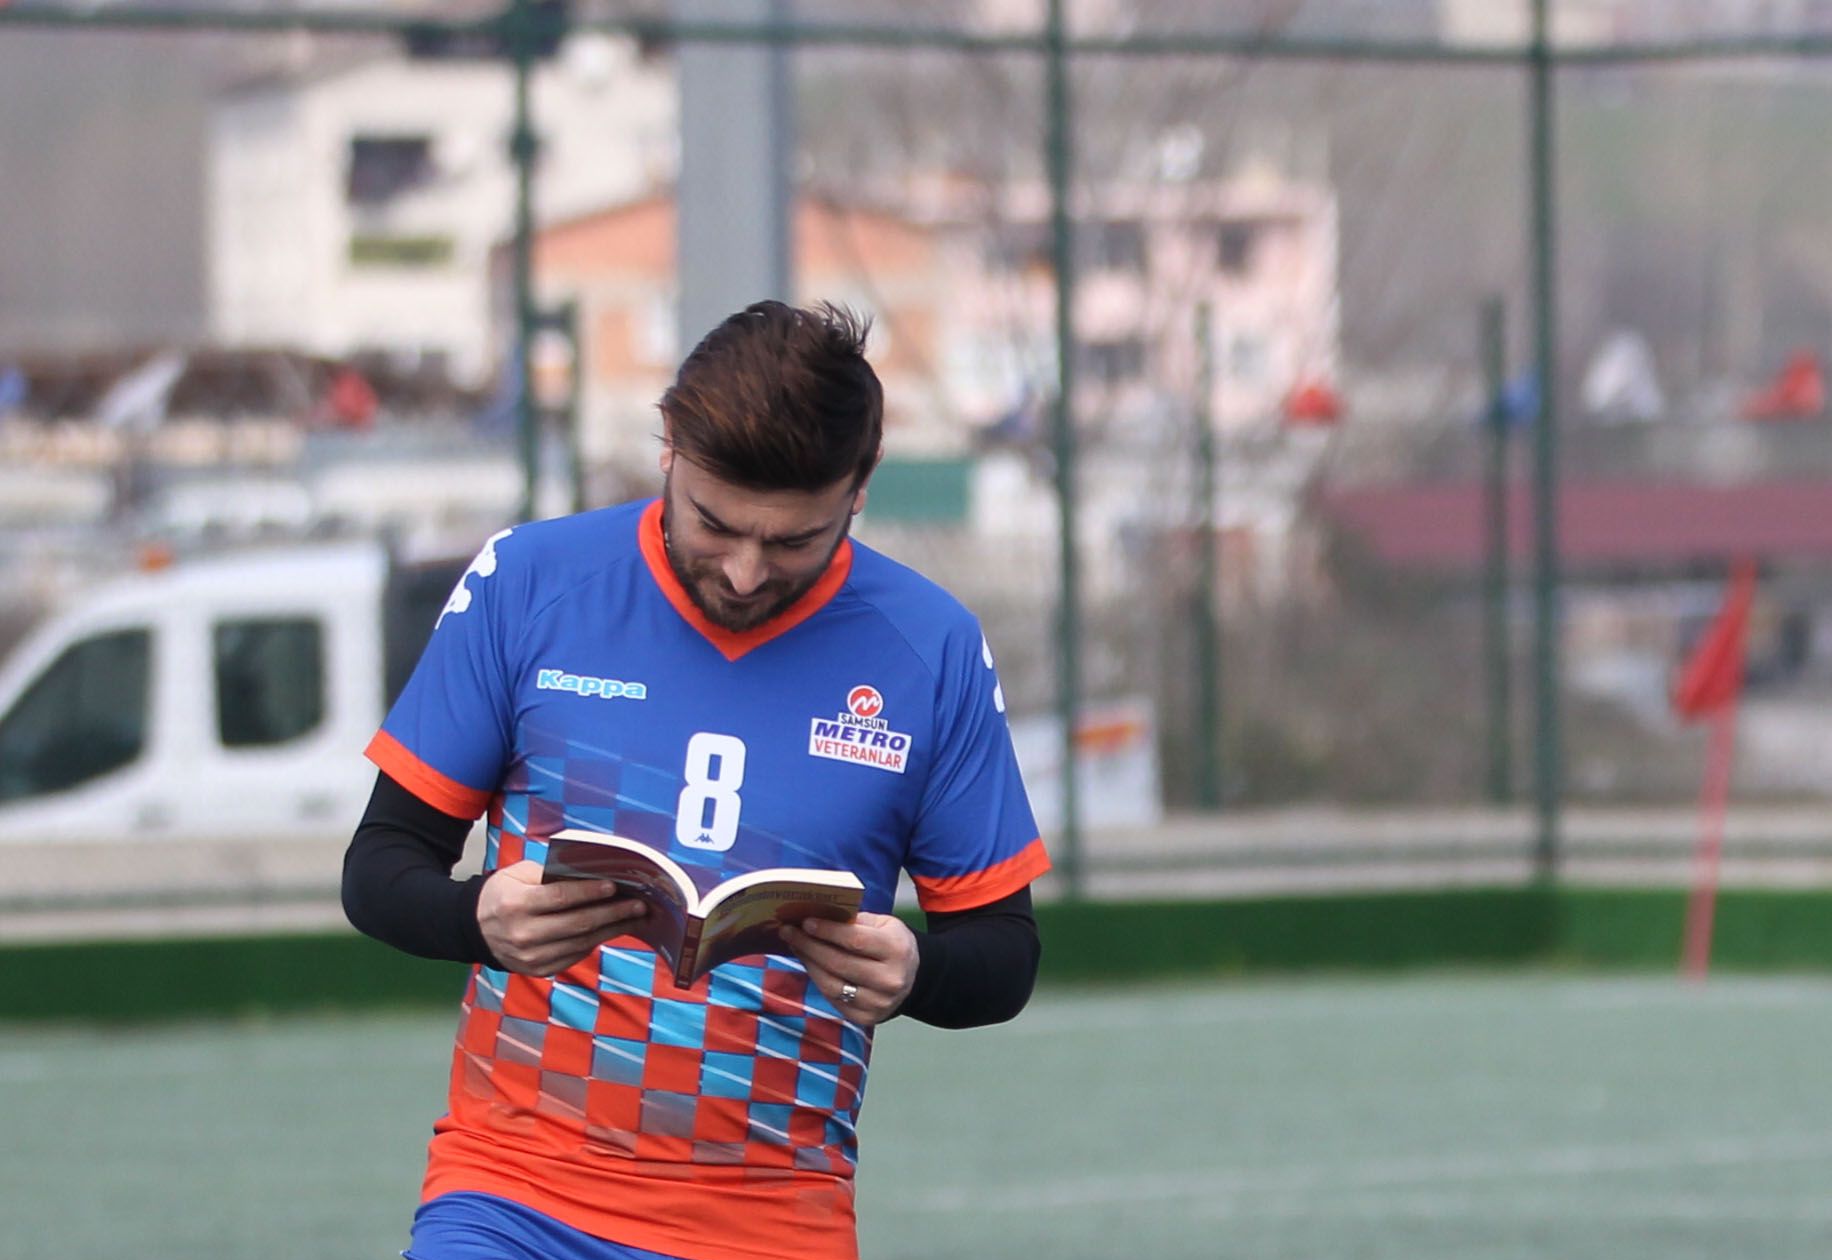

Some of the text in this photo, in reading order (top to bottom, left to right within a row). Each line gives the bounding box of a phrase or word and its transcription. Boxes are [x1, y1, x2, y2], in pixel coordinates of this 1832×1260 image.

[537, 669, 647, 700] Kappa
[814, 721, 907, 752] METRO
[840, 714, 886, 731] SAMSUN
[814, 738, 903, 770] VETERANLAR
[675, 732, 747, 852] 8
